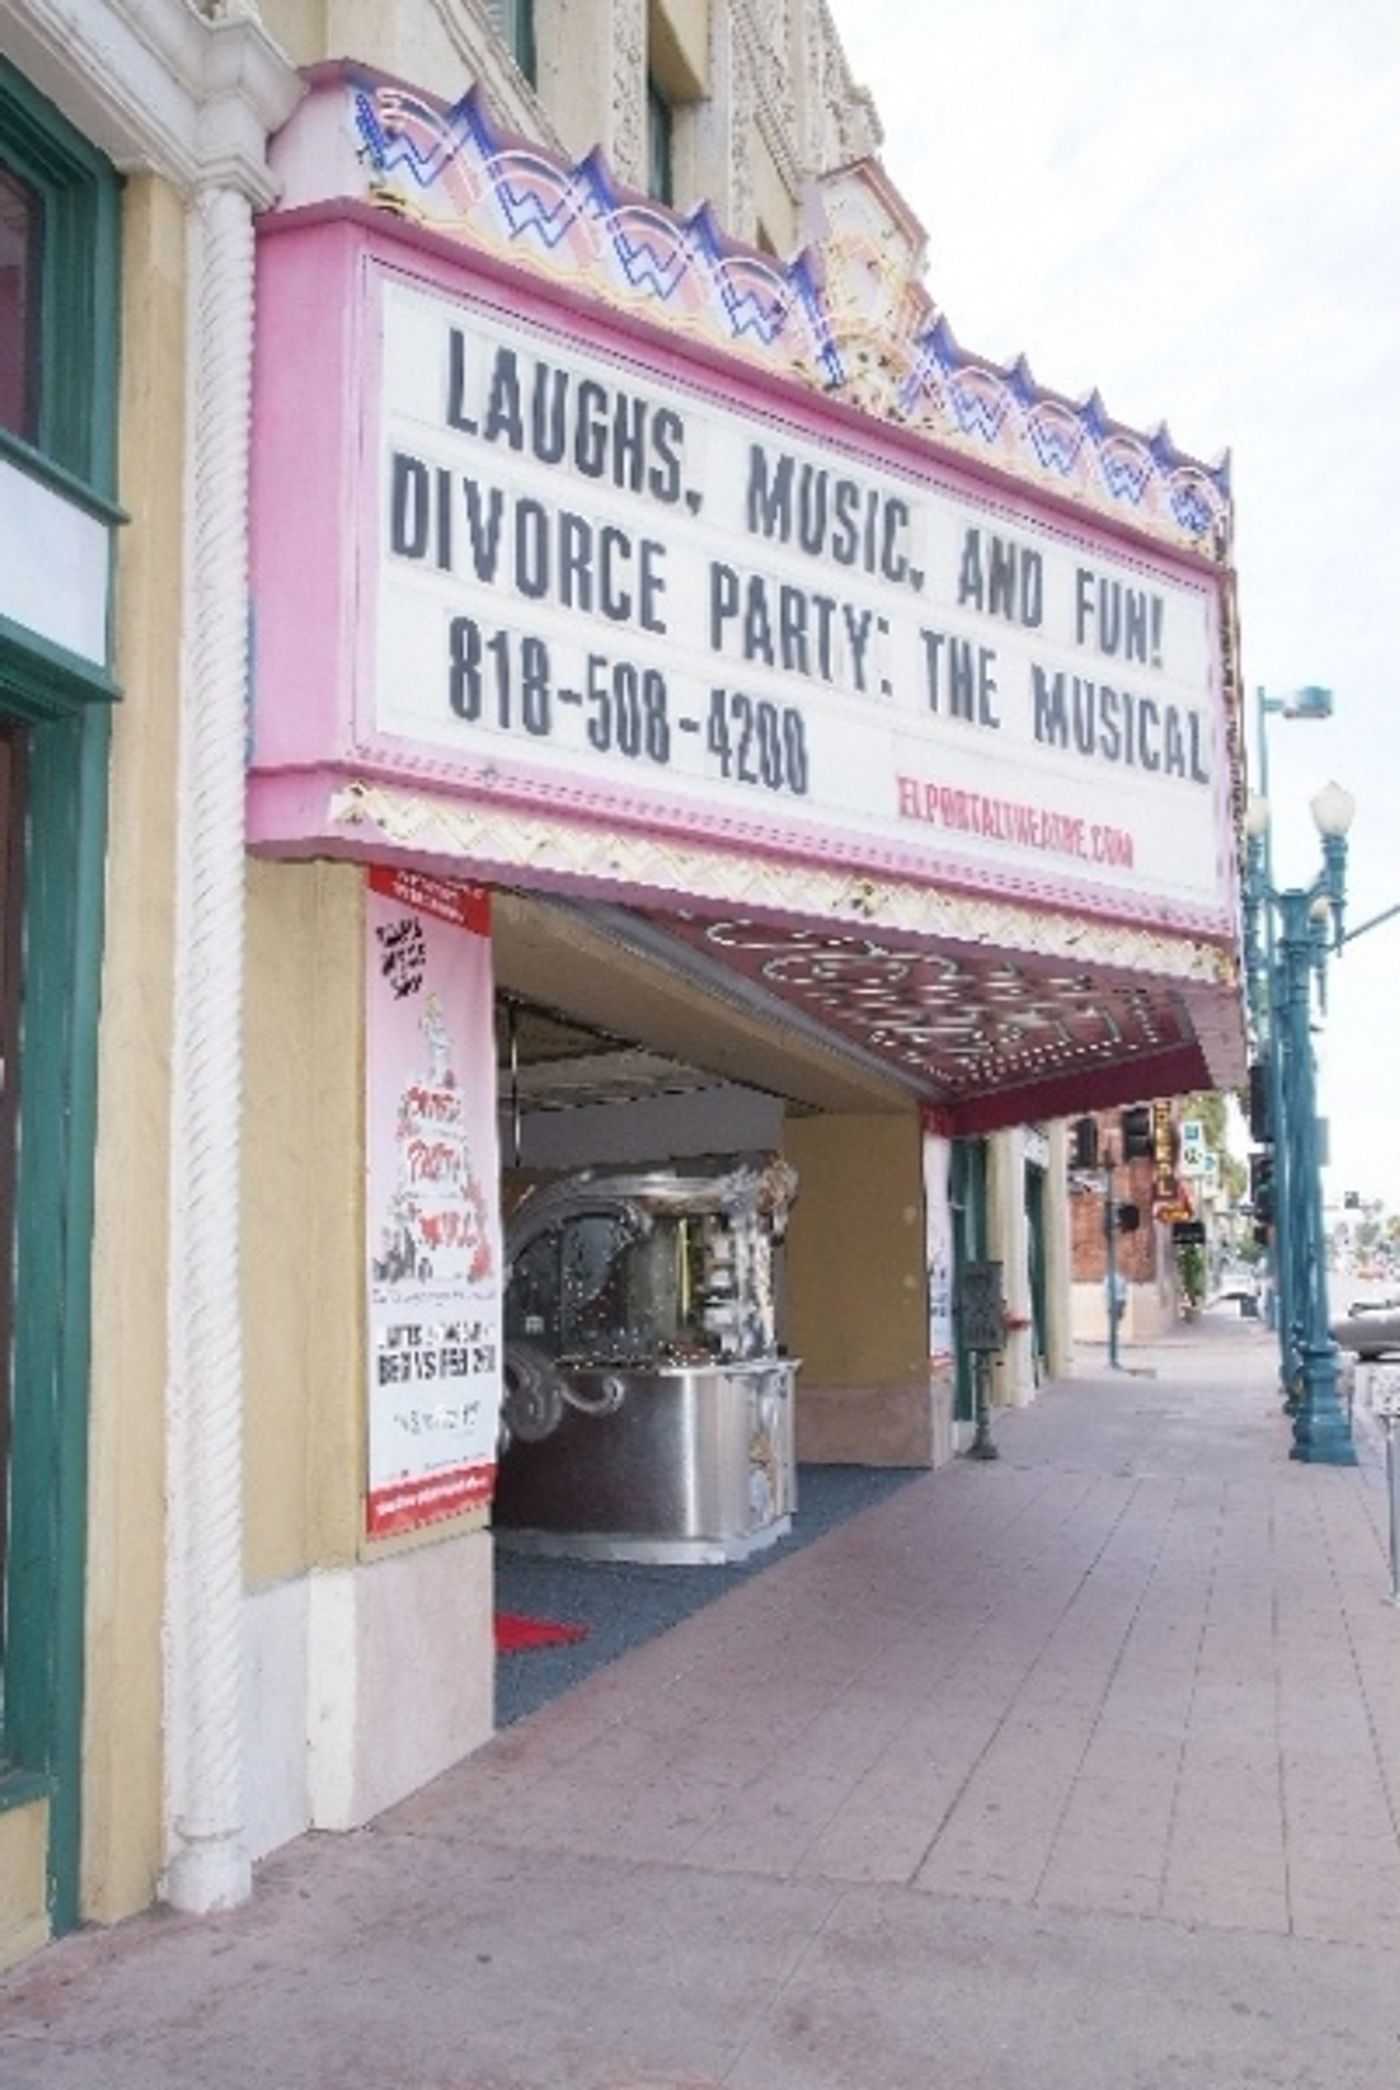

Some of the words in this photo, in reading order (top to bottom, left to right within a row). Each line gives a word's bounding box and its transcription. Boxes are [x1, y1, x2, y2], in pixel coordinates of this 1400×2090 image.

[391, 450, 667, 635] DIVORCE
[709, 559, 892, 697] PARTY:
[919, 628, 1000, 729] THE
[1030, 662, 1210, 785] MUSICAL
[446, 327, 703, 515] LAUGHS,
[746, 442, 924, 592] MUSIC,
[958, 527, 1043, 629] AND
[1075, 566, 1164, 667] FUN!
[447, 615, 809, 795] 818-508-4200
